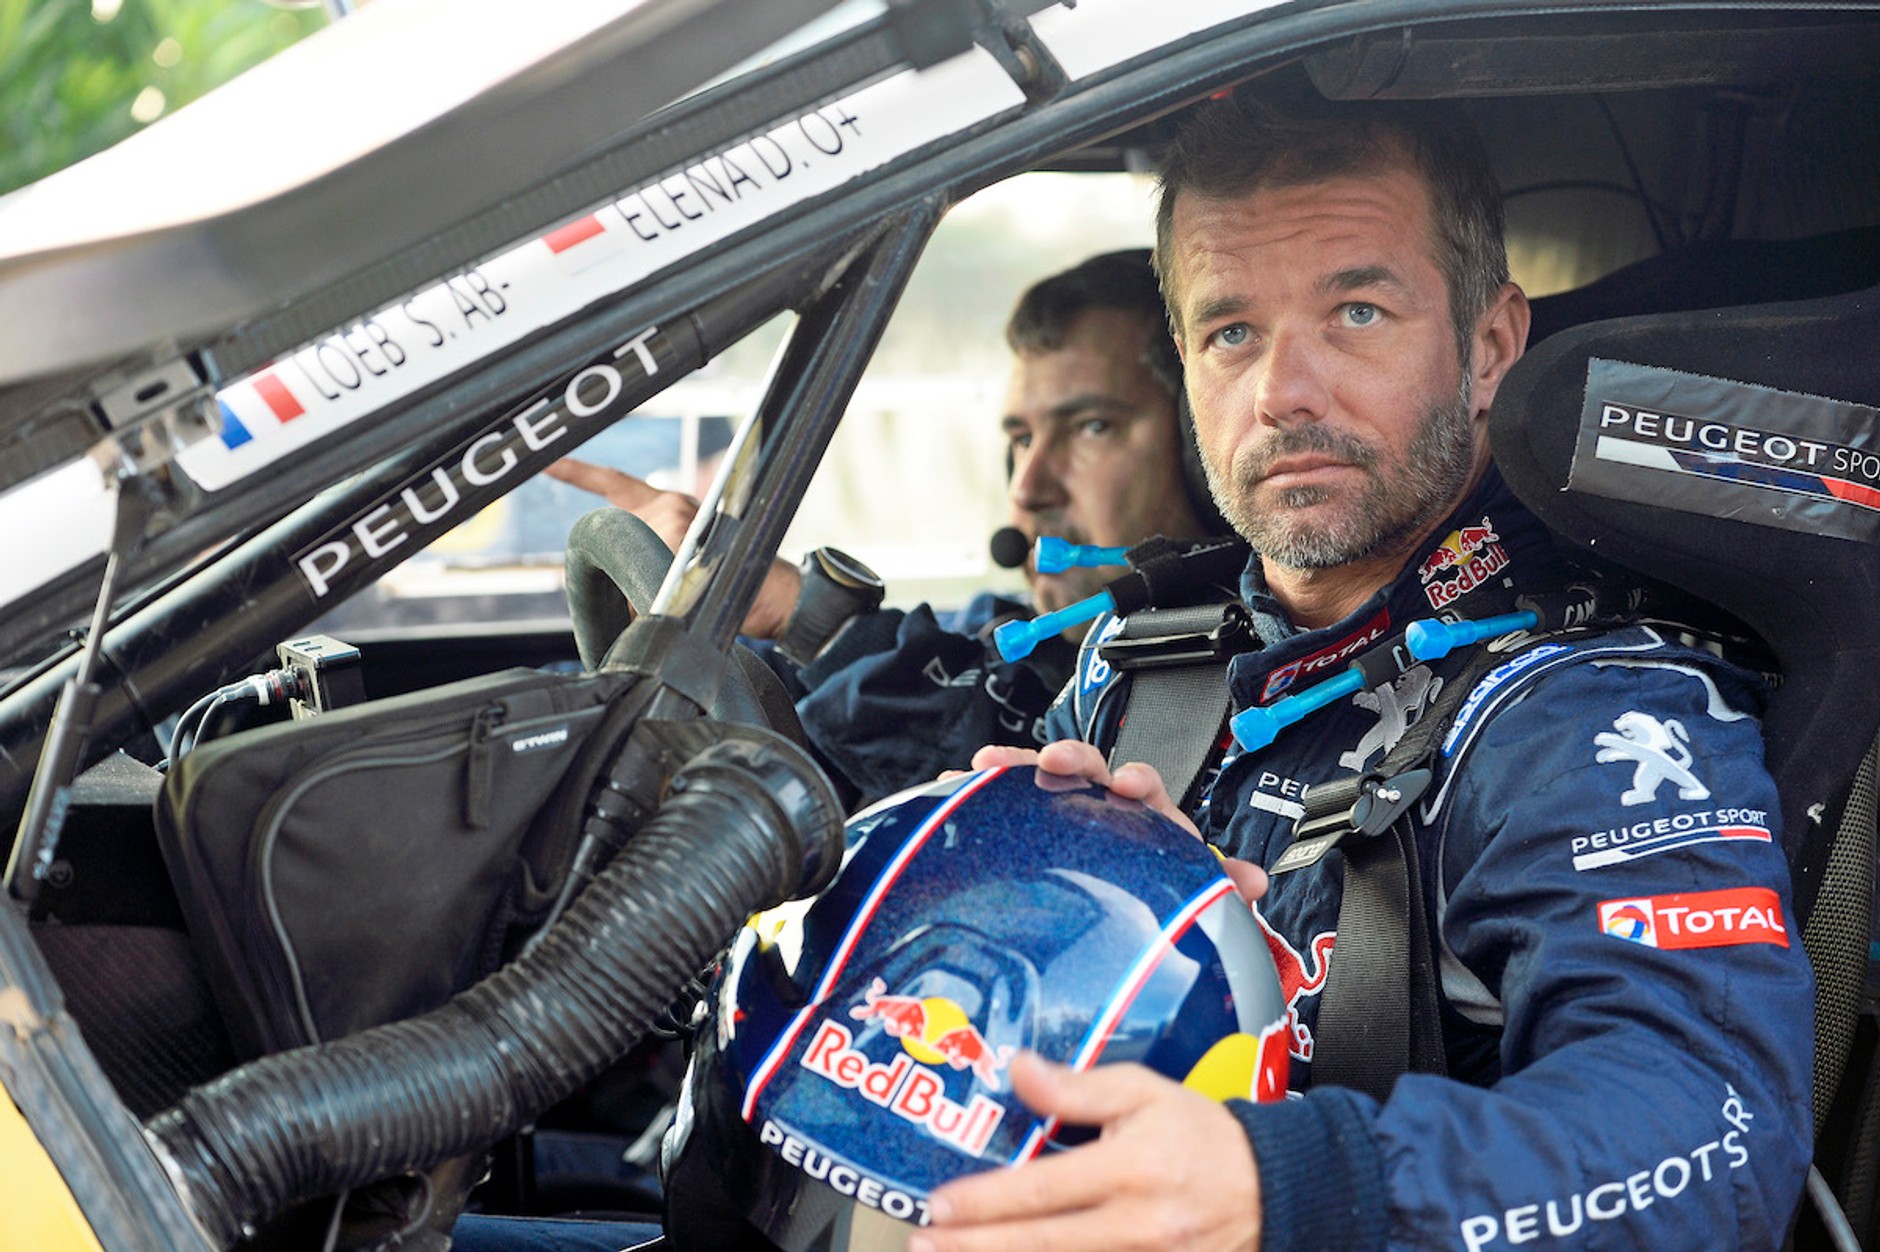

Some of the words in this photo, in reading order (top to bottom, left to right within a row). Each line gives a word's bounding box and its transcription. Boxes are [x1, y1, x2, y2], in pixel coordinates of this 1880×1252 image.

[614, 152, 762, 241] ELENA
[749, 135, 810, 180] D.
[293, 316, 405, 400] LOEB
[403, 298, 456, 347] S.
[445, 268, 509, 330] AB-
[299, 326, 660, 597] PEUGEOT
[1600, 405, 1827, 465] PEUGEOT
[1426, 567, 1473, 610] Red
[1469, 544, 1510, 584] Bull
[1304, 628, 1384, 672] TOTAL
[1571, 811, 1711, 853] PEUGEOT
[1716, 808, 1767, 826] SPORT
[1656, 906, 1785, 935] TOTAL
[804, 1022, 911, 1104] Red
[894, 1068, 1003, 1155] Bull
[760, 1120, 932, 1227] PEUGEOT
[1460, 1141, 1719, 1252] PEUGEOT
